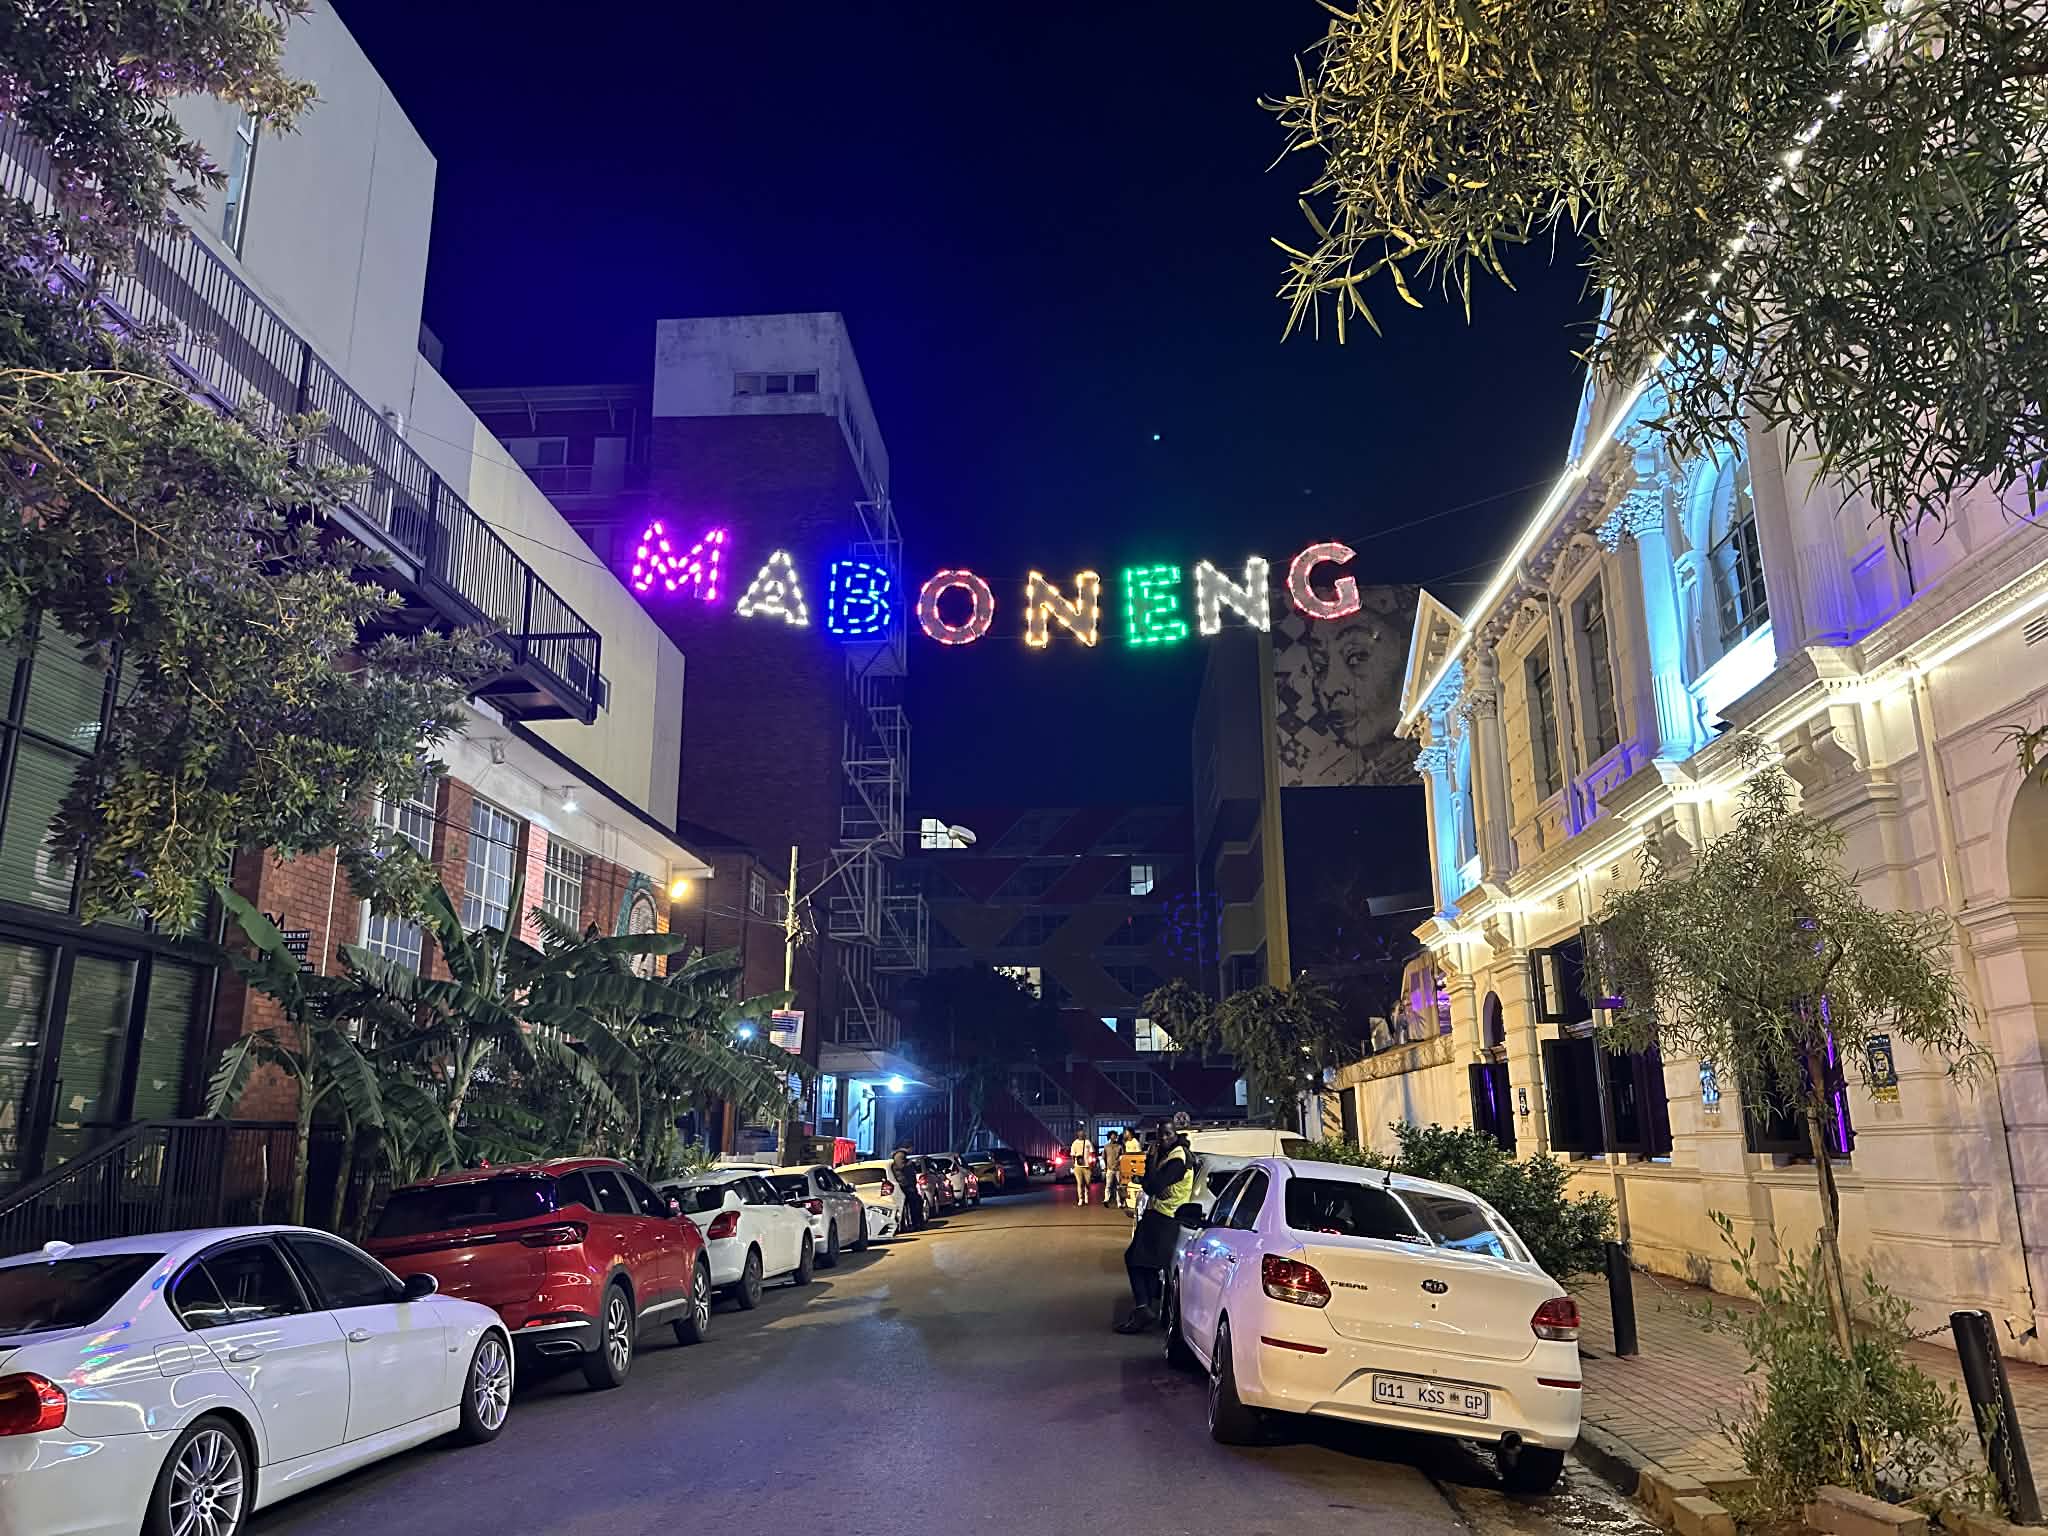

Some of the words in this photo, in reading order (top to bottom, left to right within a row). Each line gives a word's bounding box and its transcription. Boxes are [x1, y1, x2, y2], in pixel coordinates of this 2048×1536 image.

[632, 520, 1361, 647] MABONENG
[1424, 1281, 1446, 1293] KIA
[1378, 1382, 1405, 1399] 011
[1418, 1387, 1445, 1405] KSS
[1464, 1395, 1483, 1410] GP
